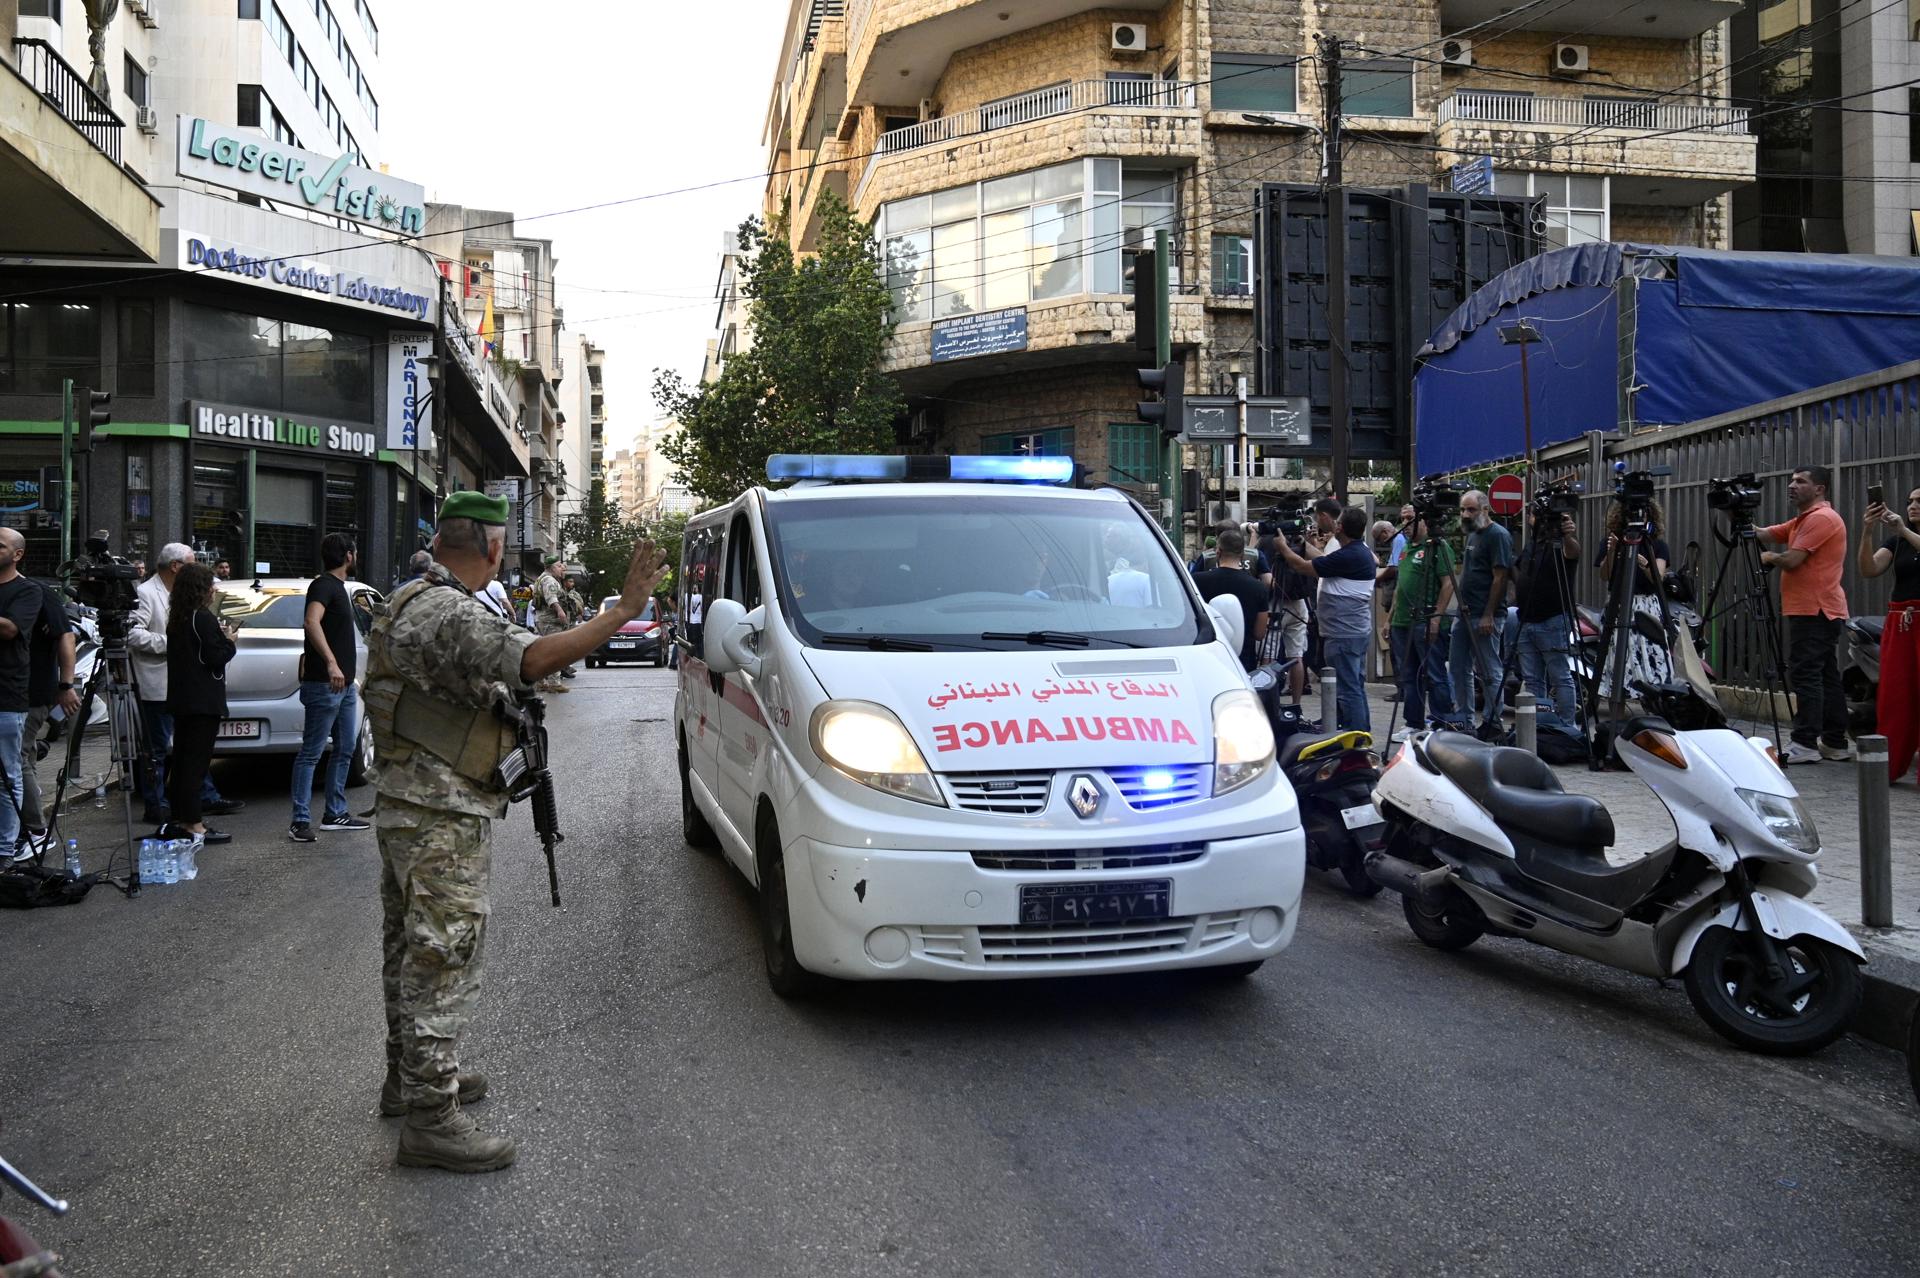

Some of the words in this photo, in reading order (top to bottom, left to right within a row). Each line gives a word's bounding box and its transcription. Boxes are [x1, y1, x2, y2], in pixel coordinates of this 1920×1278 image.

[271, 259, 334, 294] Center
[336, 272, 429, 320] Laboratory
[932, 320, 950, 330] BEIRUT
[951, 317, 974, 327] IMPLANT
[975, 312, 1003, 323] DENTISTRY
[1003, 308, 1025, 318] CENTRE
[392, 334, 429, 344] CENTER
[402, 346, 418, 446] MARIGNAN
[198, 406, 320, 447] HealthLine
[328, 425, 376, 456] Shop
[927, 682, 1021, 710] اللبناني
[1031, 678, 1100, 703] المدني
[1106, 679, 1178, 700] الدفاع
